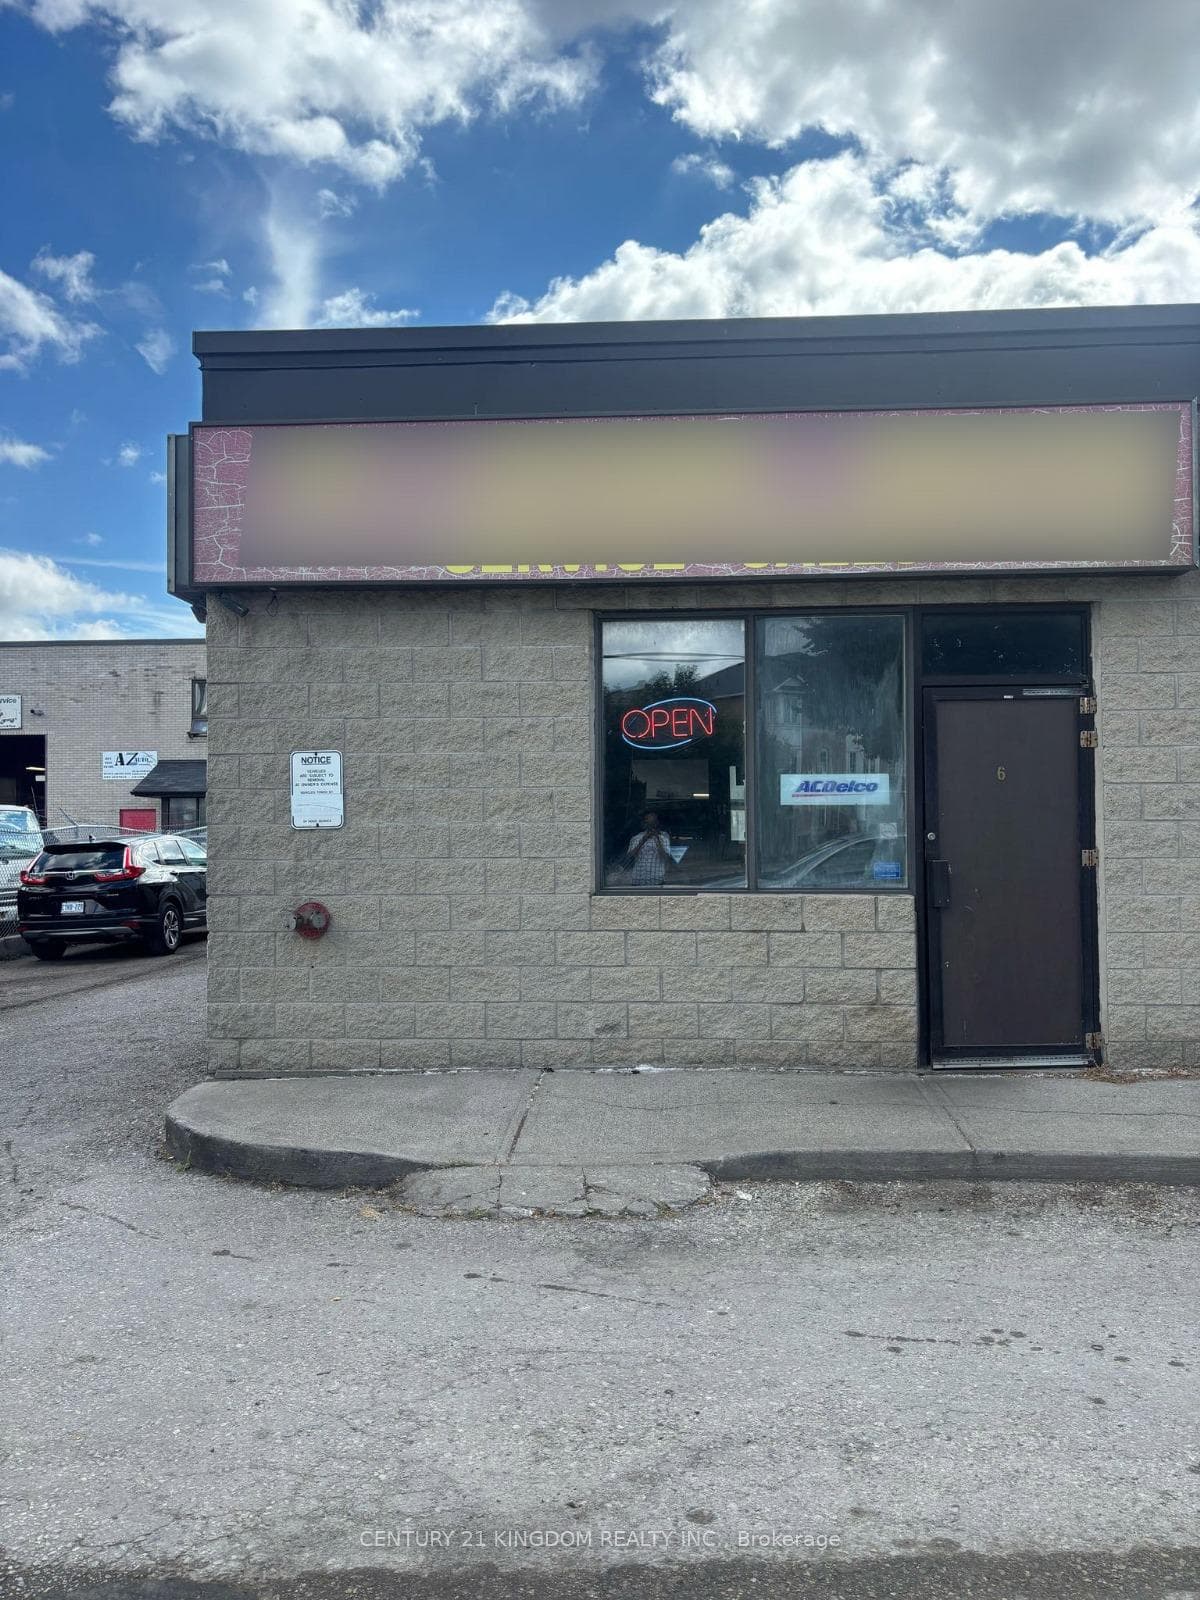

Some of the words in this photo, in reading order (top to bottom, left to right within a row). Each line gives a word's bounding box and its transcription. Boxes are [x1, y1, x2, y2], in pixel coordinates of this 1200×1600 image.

[622, 706, 713, 738] OPEN
[301, 756, 332, 765] NOTICE
[997, 766, 1006, 781] 6
[796, 780, 879, 793] ACDelco
